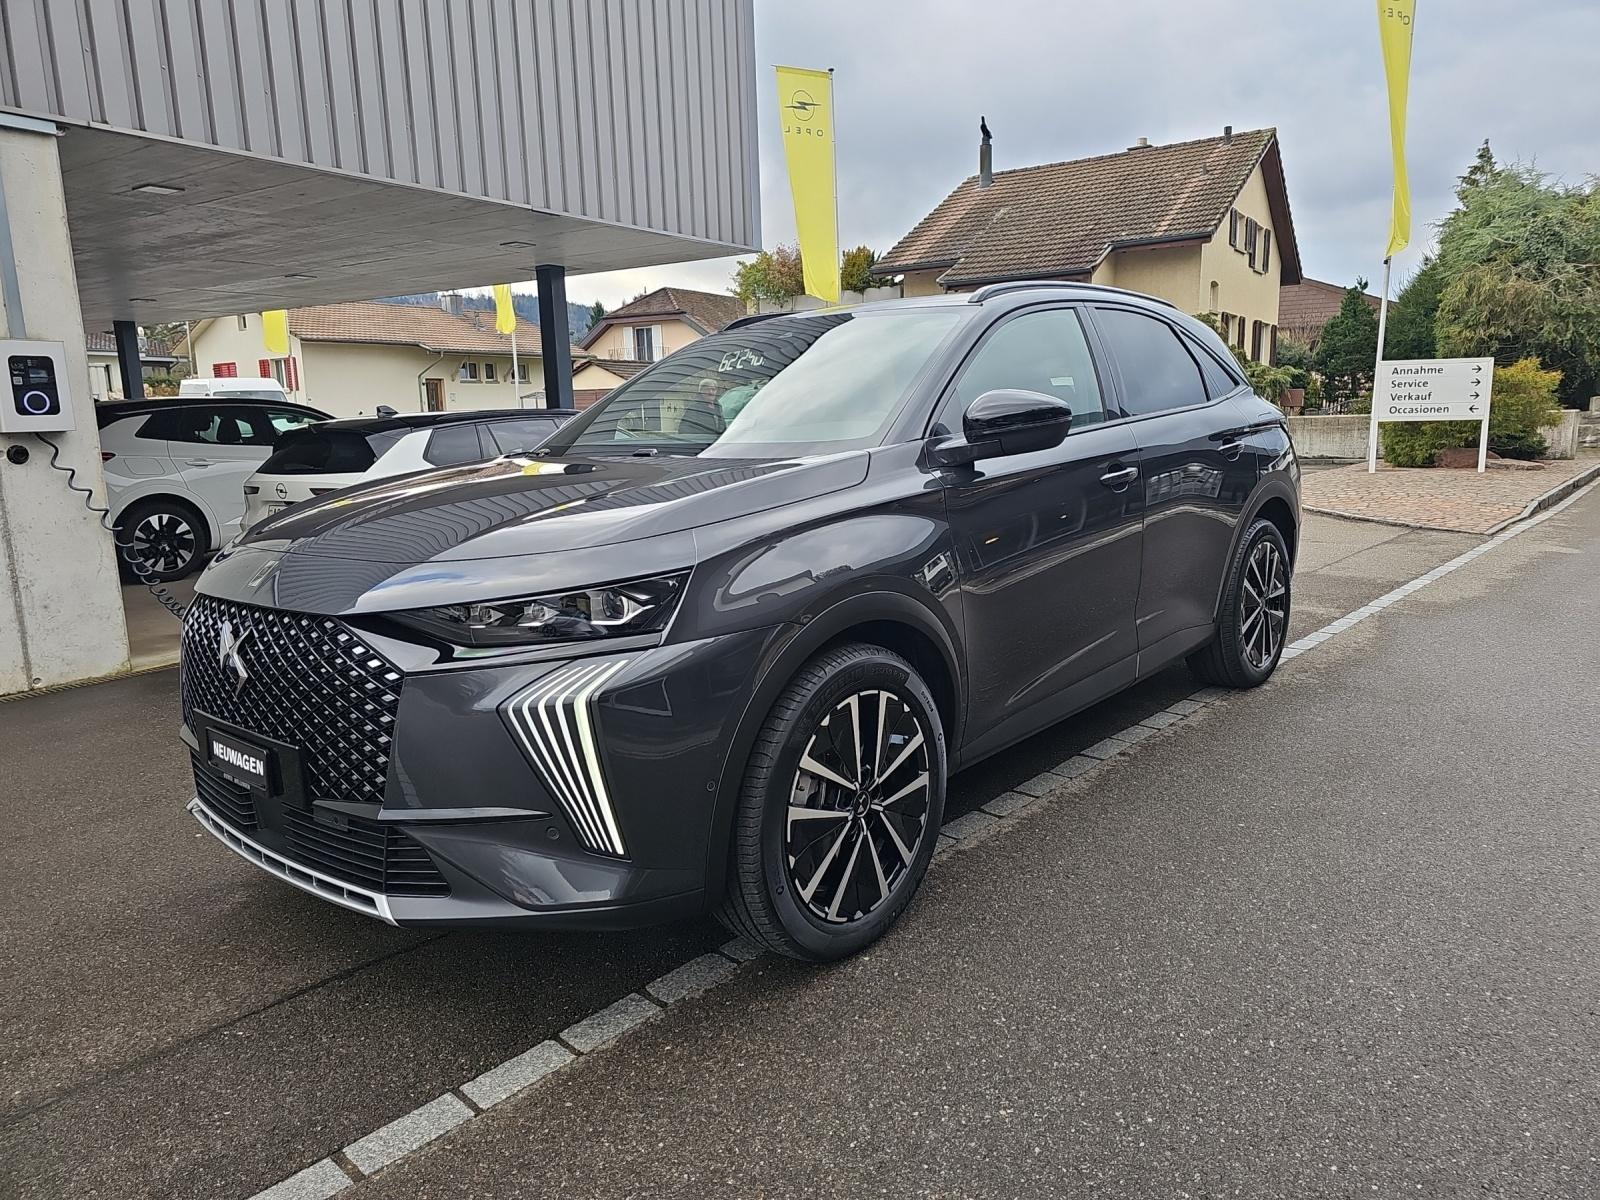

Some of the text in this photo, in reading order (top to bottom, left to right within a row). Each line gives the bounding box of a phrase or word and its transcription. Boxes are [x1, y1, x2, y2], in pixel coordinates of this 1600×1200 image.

[1391, 366, 1444, 376] Annahme
[1391, 379, 1429, 389] Service
[1390, 391, 1433, 402] Verkauf
[1389, 405, 1450, 415] Occasionen
[212, 740, 264, 777] NEUWAGEN
